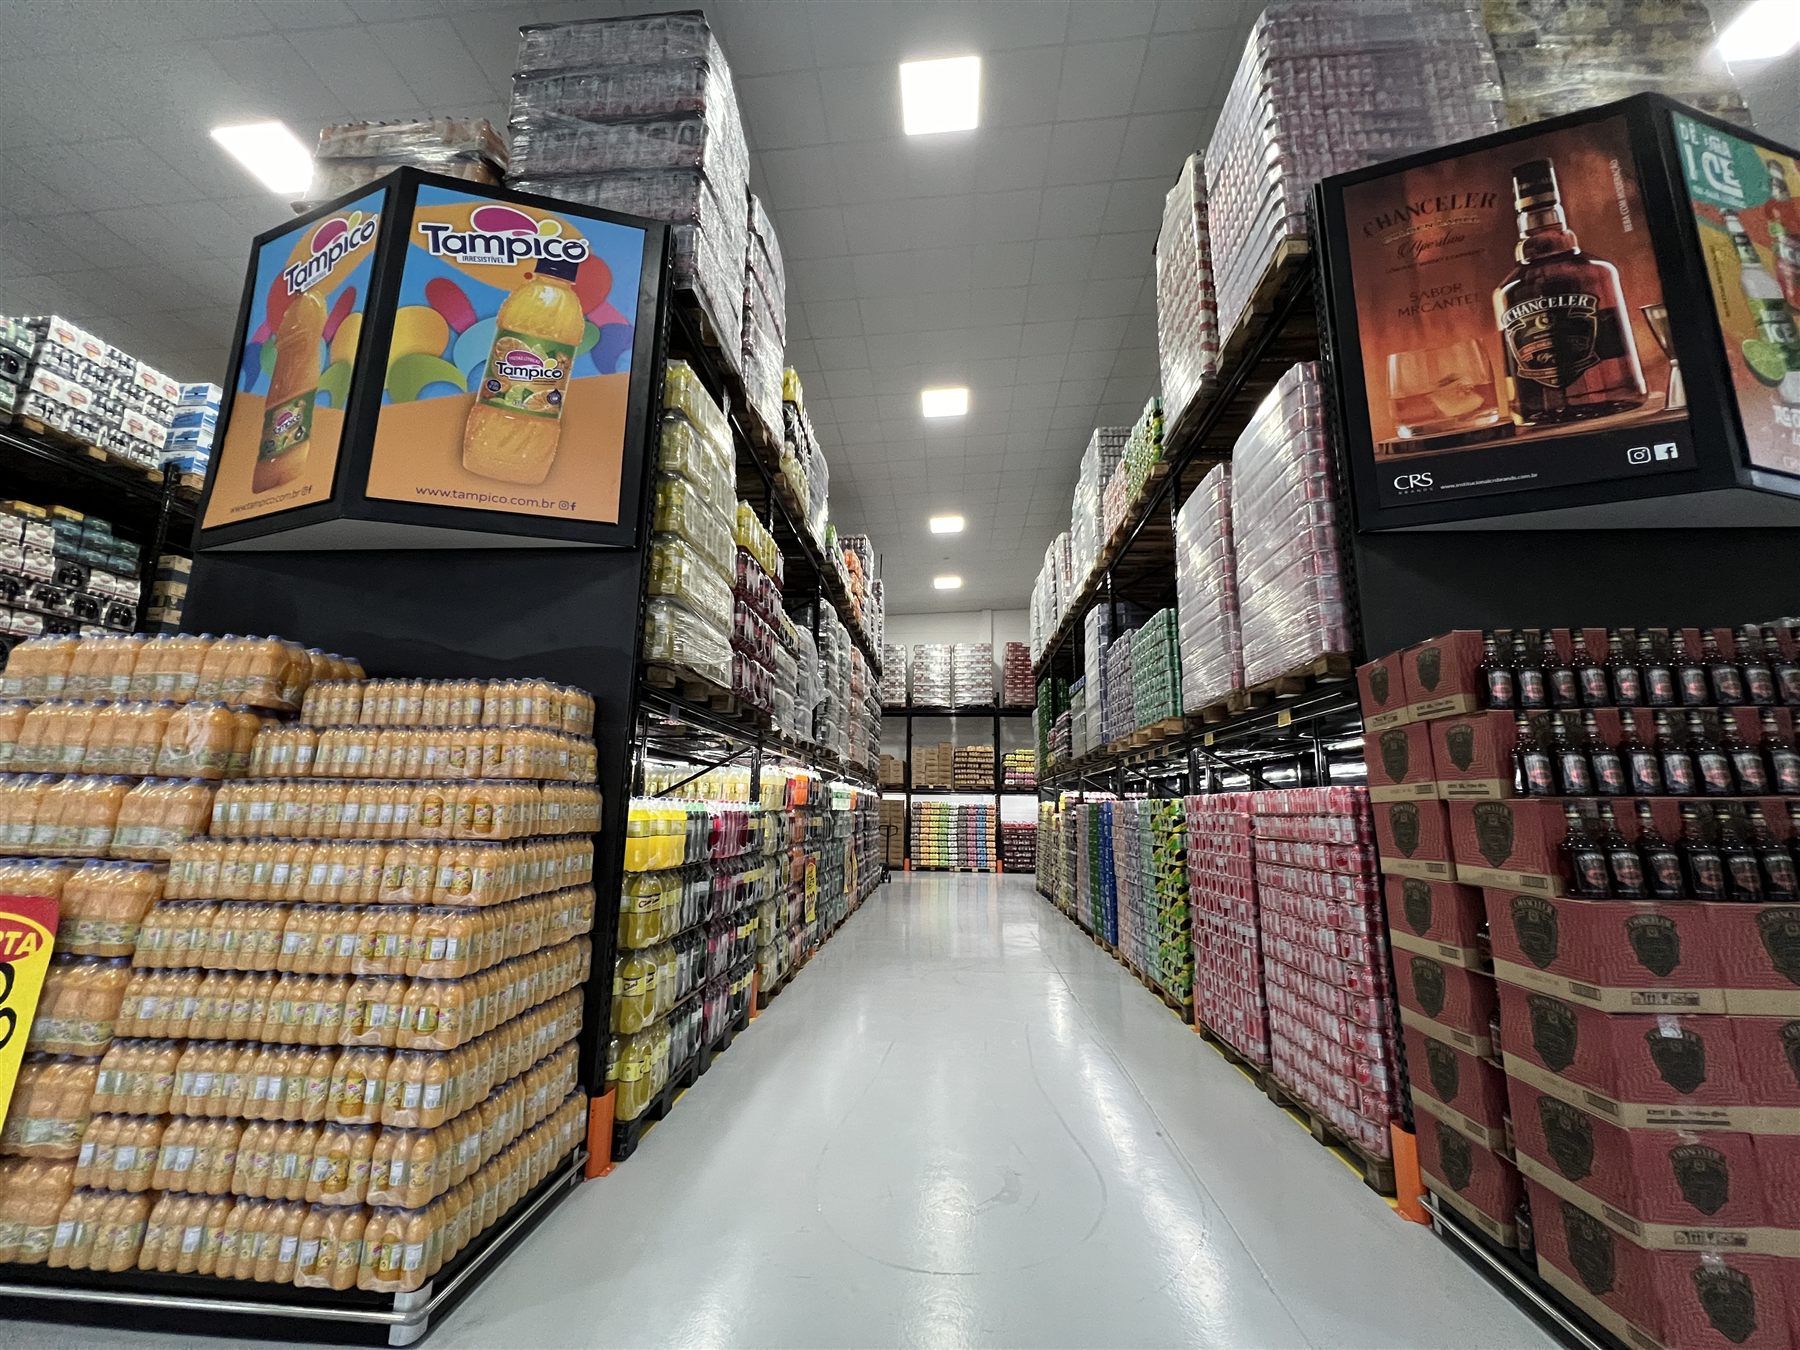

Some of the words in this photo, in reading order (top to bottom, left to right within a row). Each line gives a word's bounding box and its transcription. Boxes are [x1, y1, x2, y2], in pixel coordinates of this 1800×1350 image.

[1362, 191, 1499, 239] CHANCELER
[284, 219, 376, 293] Tampico
[421, 223, 587, 264] Tampico
[1506, 296, 1589, 322] CHANCELER
[496, 361, 563, 380] Tampico
[1393, 471, 1434, 490] CRS
[415, 485, 556, 510] www.tampico.com.br
[0, 930, 38, 956] TA
